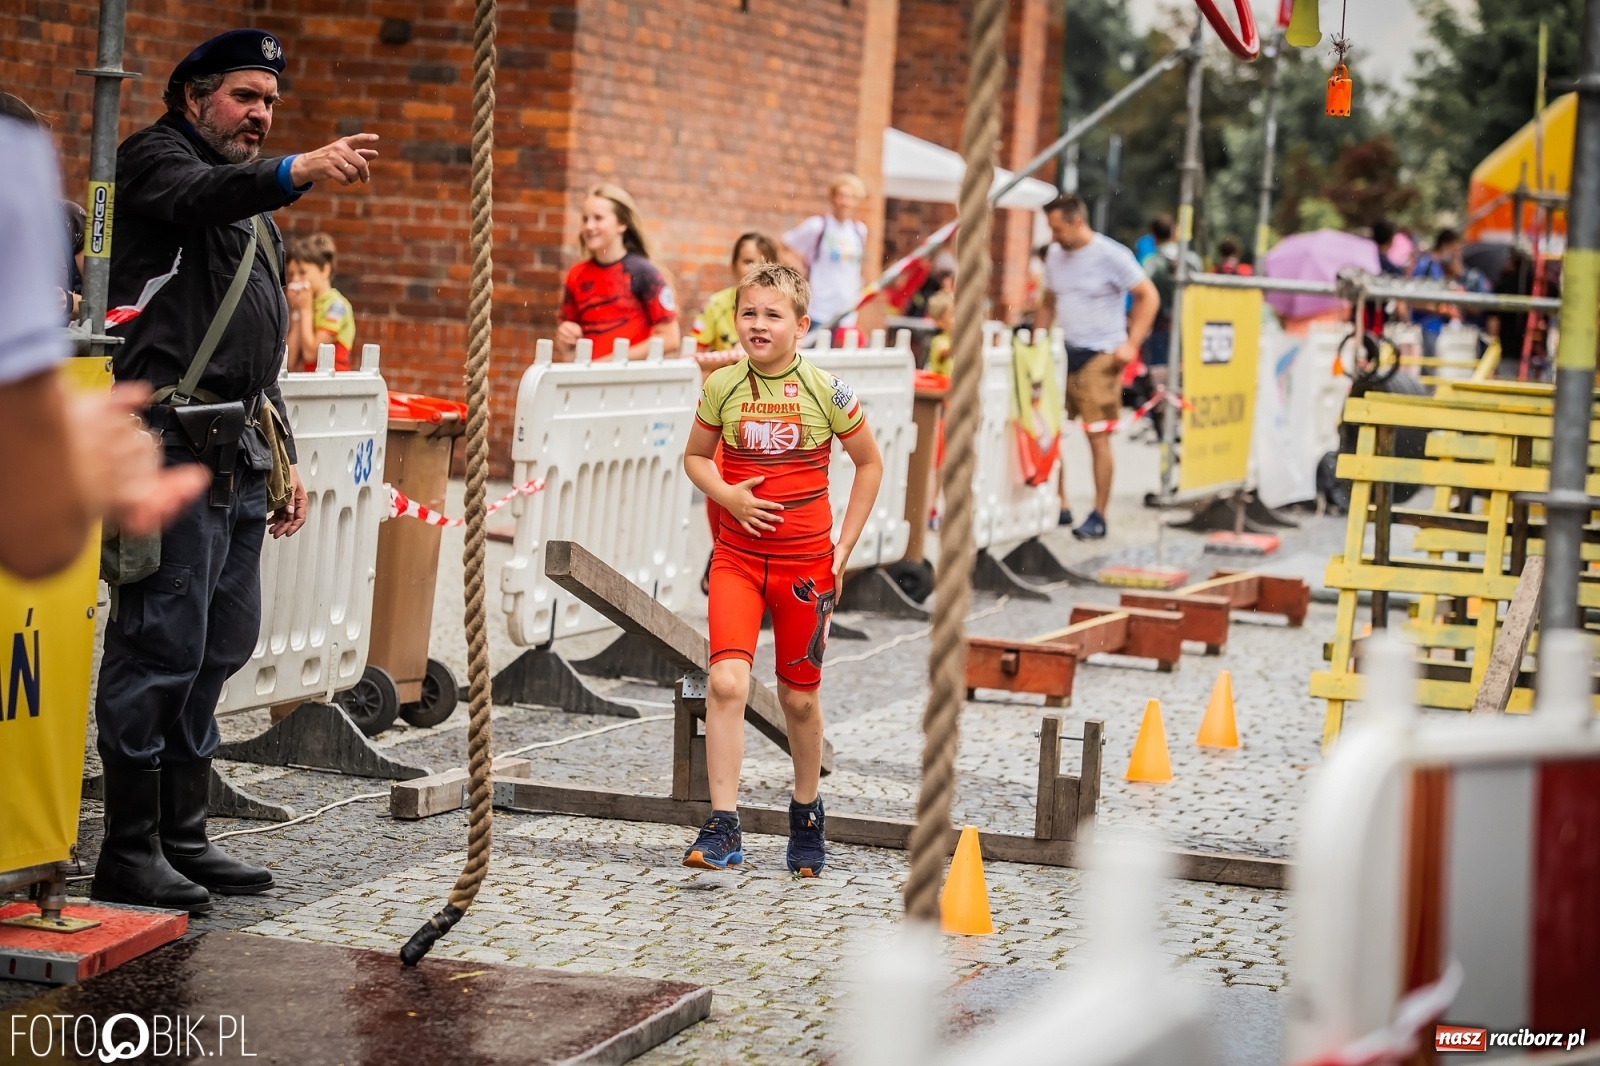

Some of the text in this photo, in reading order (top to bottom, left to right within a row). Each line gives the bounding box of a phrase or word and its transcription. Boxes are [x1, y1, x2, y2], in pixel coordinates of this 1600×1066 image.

[92, 187, 106, 253] ERIGO
[741, 402, 801, 414] RACIBORKI
[354, 438, 374, 486] 83
[0, 607, 41, 722] Ń
